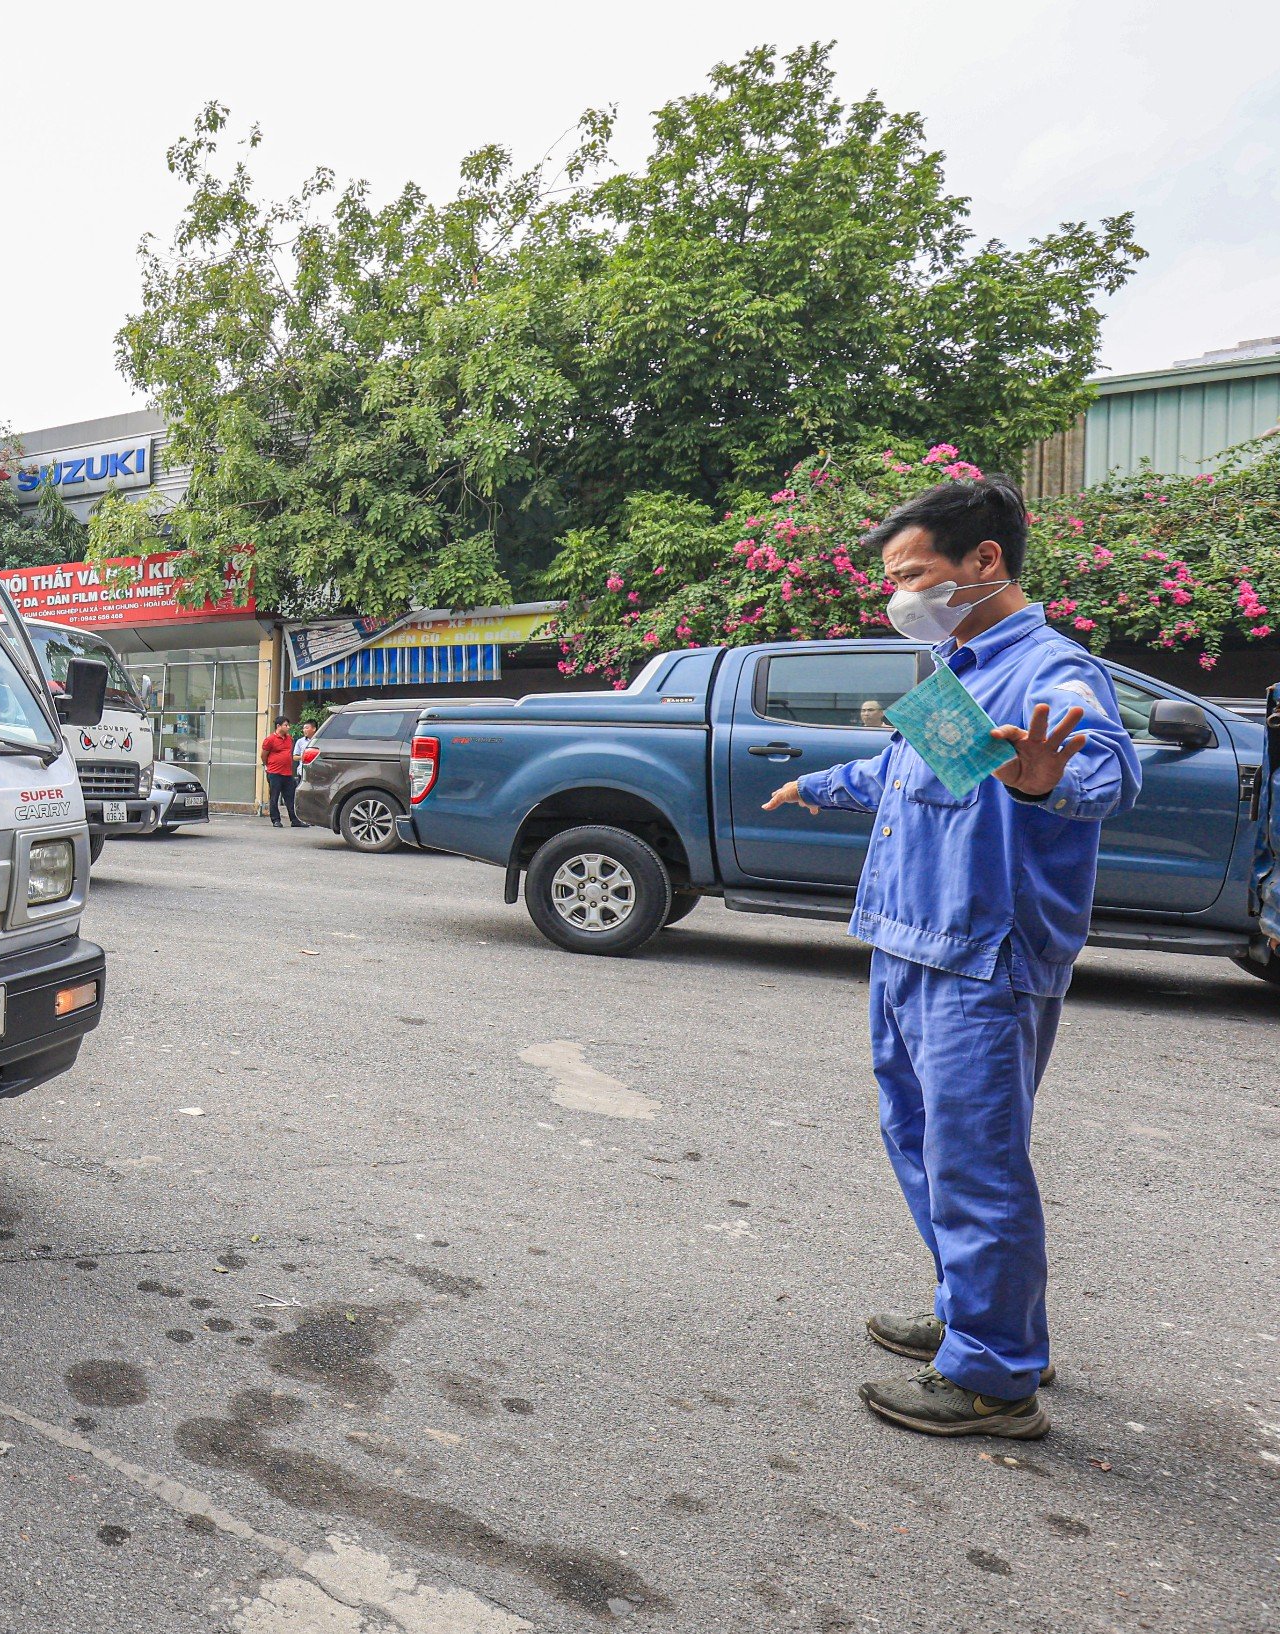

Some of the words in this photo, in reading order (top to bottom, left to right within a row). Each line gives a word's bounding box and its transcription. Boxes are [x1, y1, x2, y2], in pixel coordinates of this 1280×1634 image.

[17, 448, 145, 491] SUZUKI
[31, 567, 74, 591] THẤT
[77, 565, 100, 585] VÀ
[23, 597, 39, 608] DA
[46, 592, 70, 606] DÁN
[72, 592, 98, 605] FILM
[136, 582, 173, 598] NHIỆT
[115, 602, 139, 610] CHUNG
[20, 788, 64, 802] SUPER
[15, 801, 71, 821] CARRY
